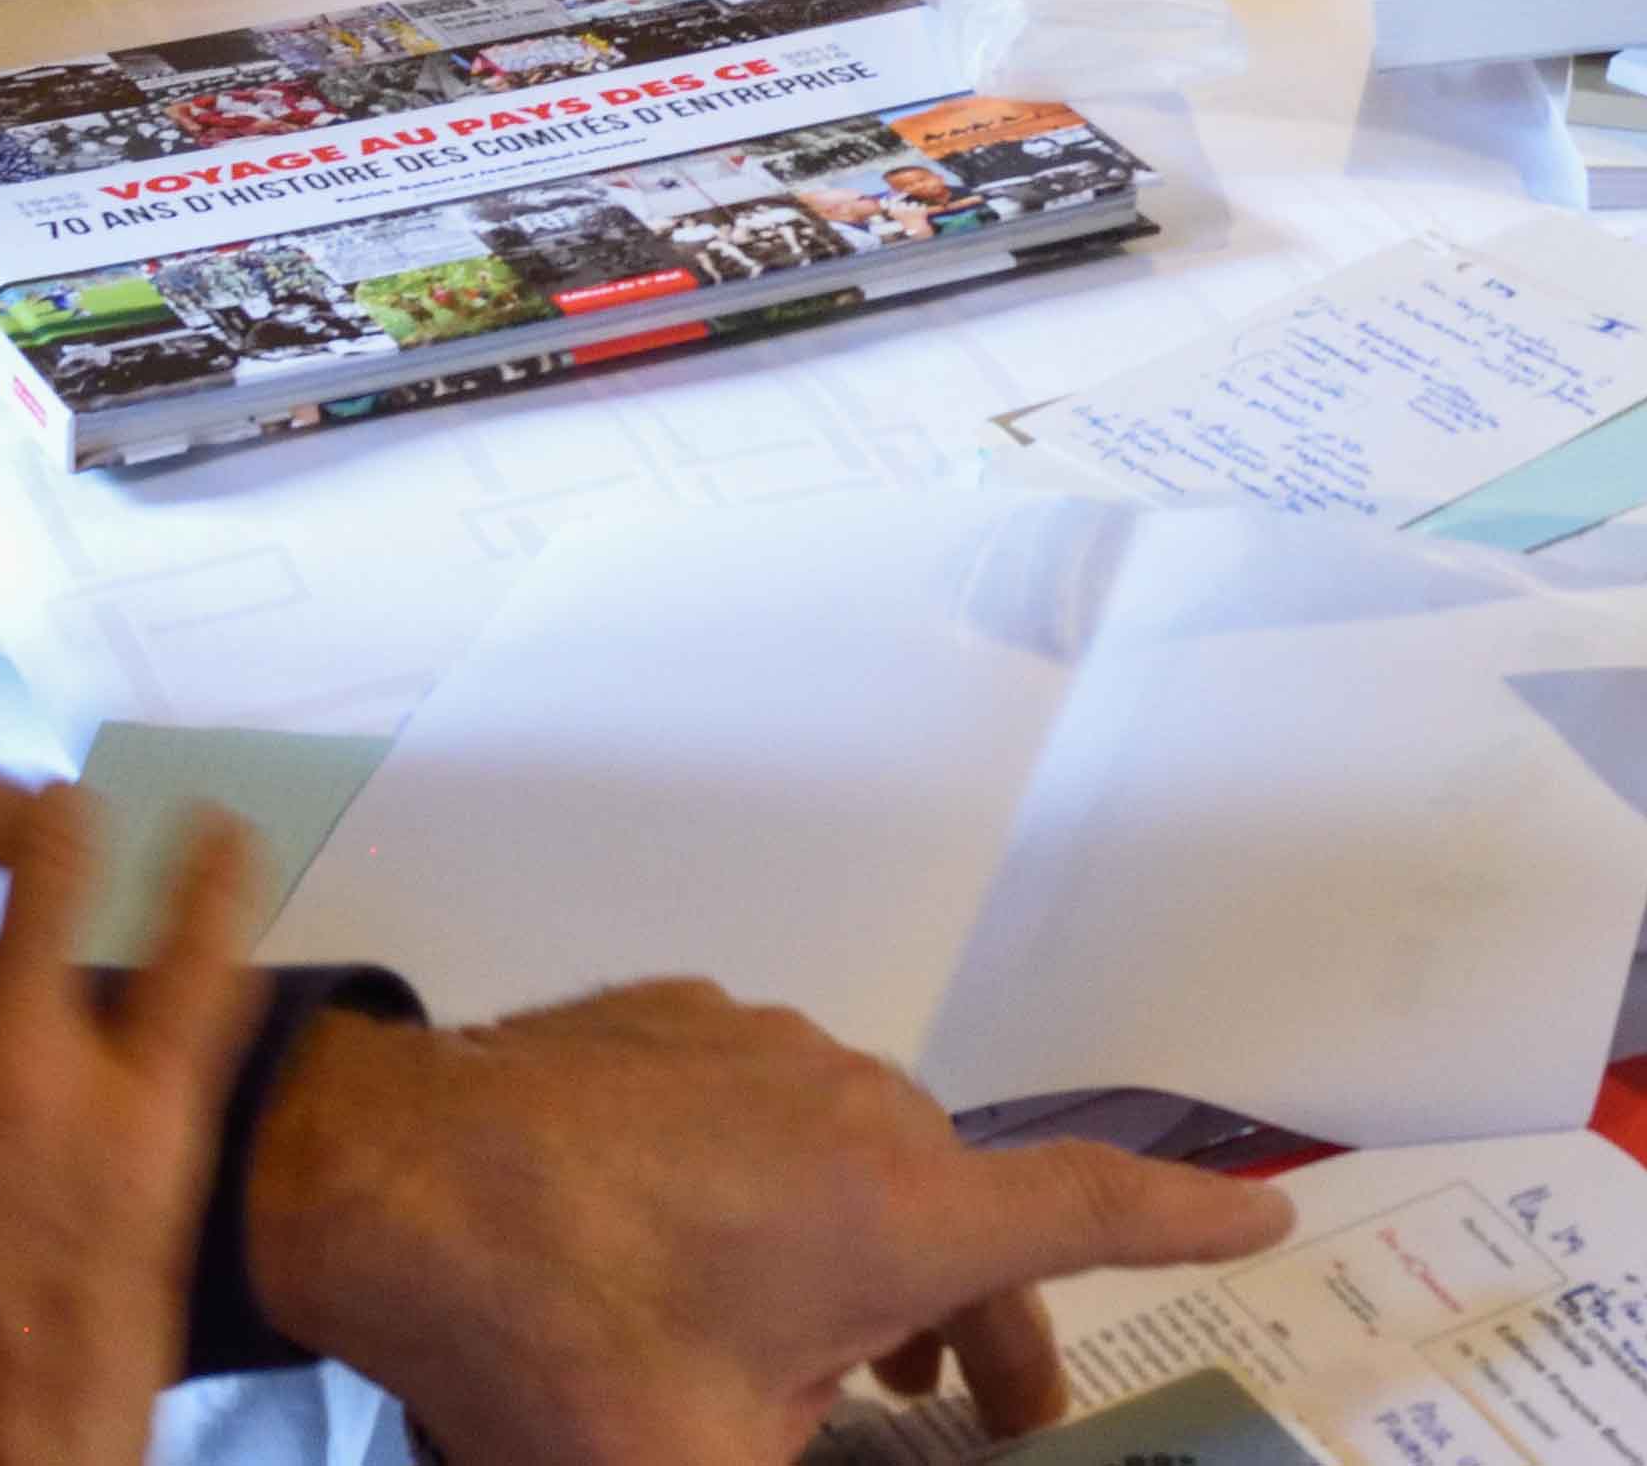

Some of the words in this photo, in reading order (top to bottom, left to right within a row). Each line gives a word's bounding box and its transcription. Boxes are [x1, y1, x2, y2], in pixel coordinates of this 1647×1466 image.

[36, 216, 92, 242] 70
[93, 200, 178, 232] ANS
[186, 158, 390, 215] D'HISTOIRE
[400, 144, 469, 174] DES
[472, 105, 633, 158] COMITÉS
[637, 59, 878, 124] D'ENTREPRISE
[98, 145, 348, 202] VOYAGE
[360, 126, 438, 157] AU
[447, 96, 593, 137] PAYS
[598, 73, 705, 107] DES
[712, 58, 778, 81] CE
